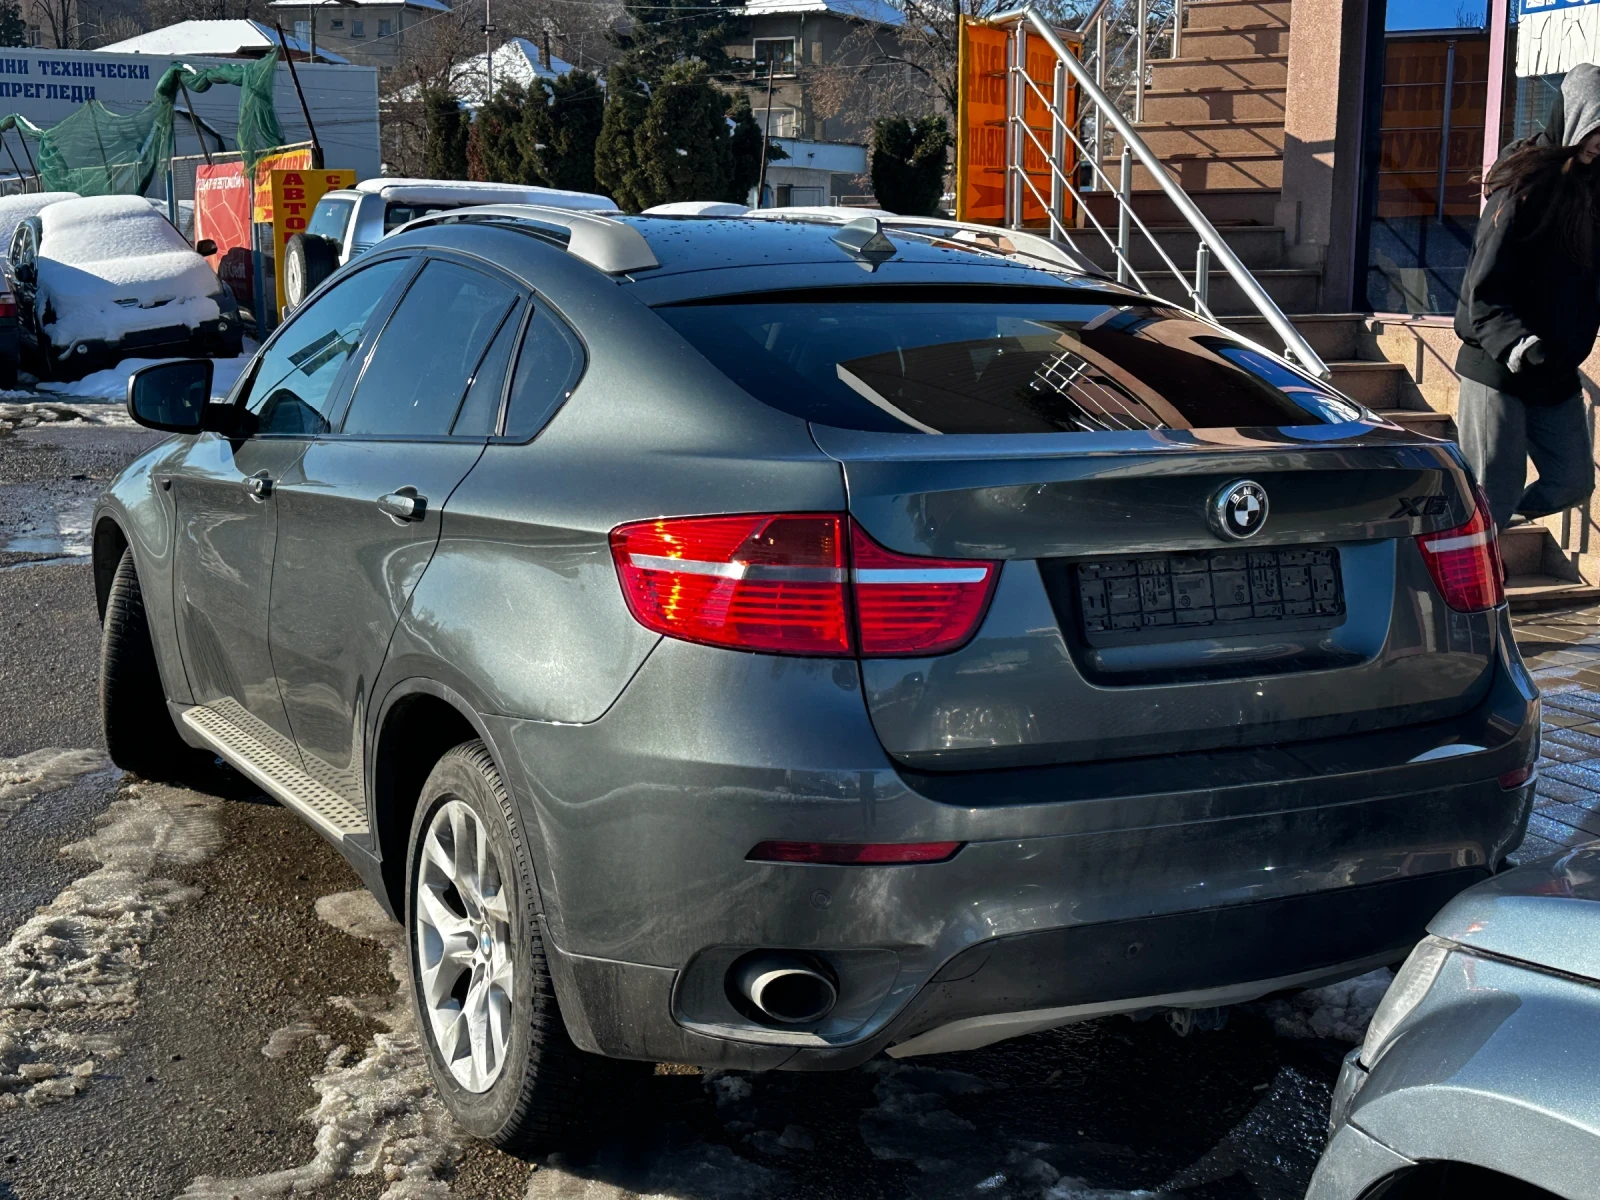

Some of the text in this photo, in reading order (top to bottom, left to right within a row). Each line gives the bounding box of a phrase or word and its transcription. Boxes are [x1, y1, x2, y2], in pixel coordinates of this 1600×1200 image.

[38, 60, 150, 79] ТЕХНИЧЕСКИ
[0, 82, 96, 103] ПРЕГЛЕДИ
[1388, 496, 1450, 519] X6
